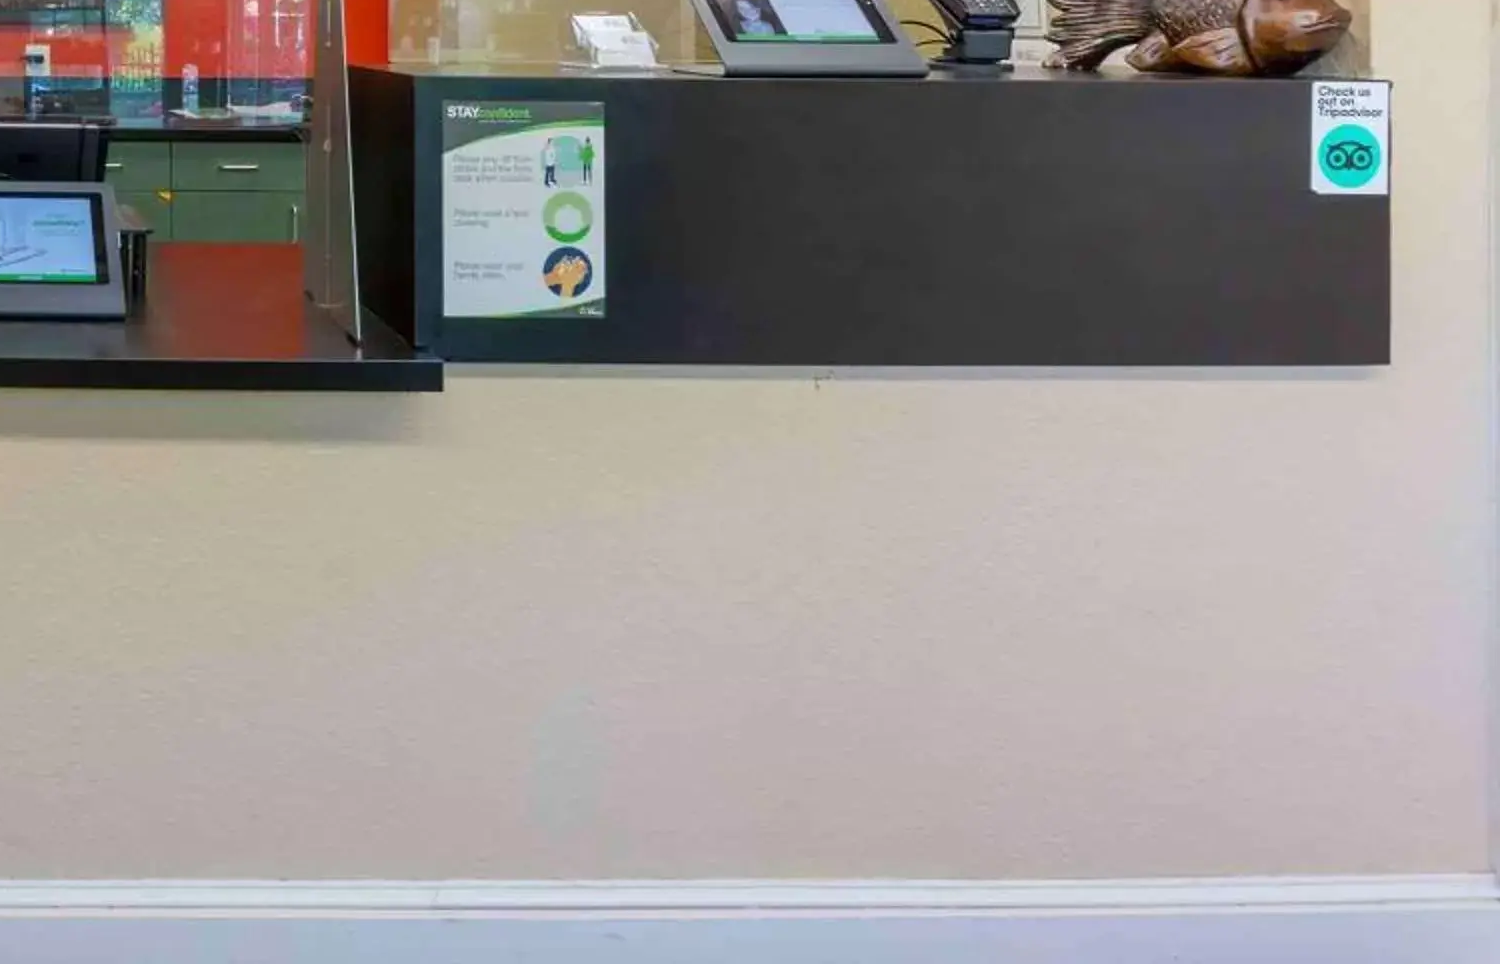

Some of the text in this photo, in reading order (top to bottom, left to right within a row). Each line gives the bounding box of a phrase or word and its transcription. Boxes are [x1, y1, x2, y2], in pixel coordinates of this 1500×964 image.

[1317, 85, 1372, 97] Check us
[1317, 96, 1355, 107] out on
[1317, 105, 1384, 118] Tripadvisor
